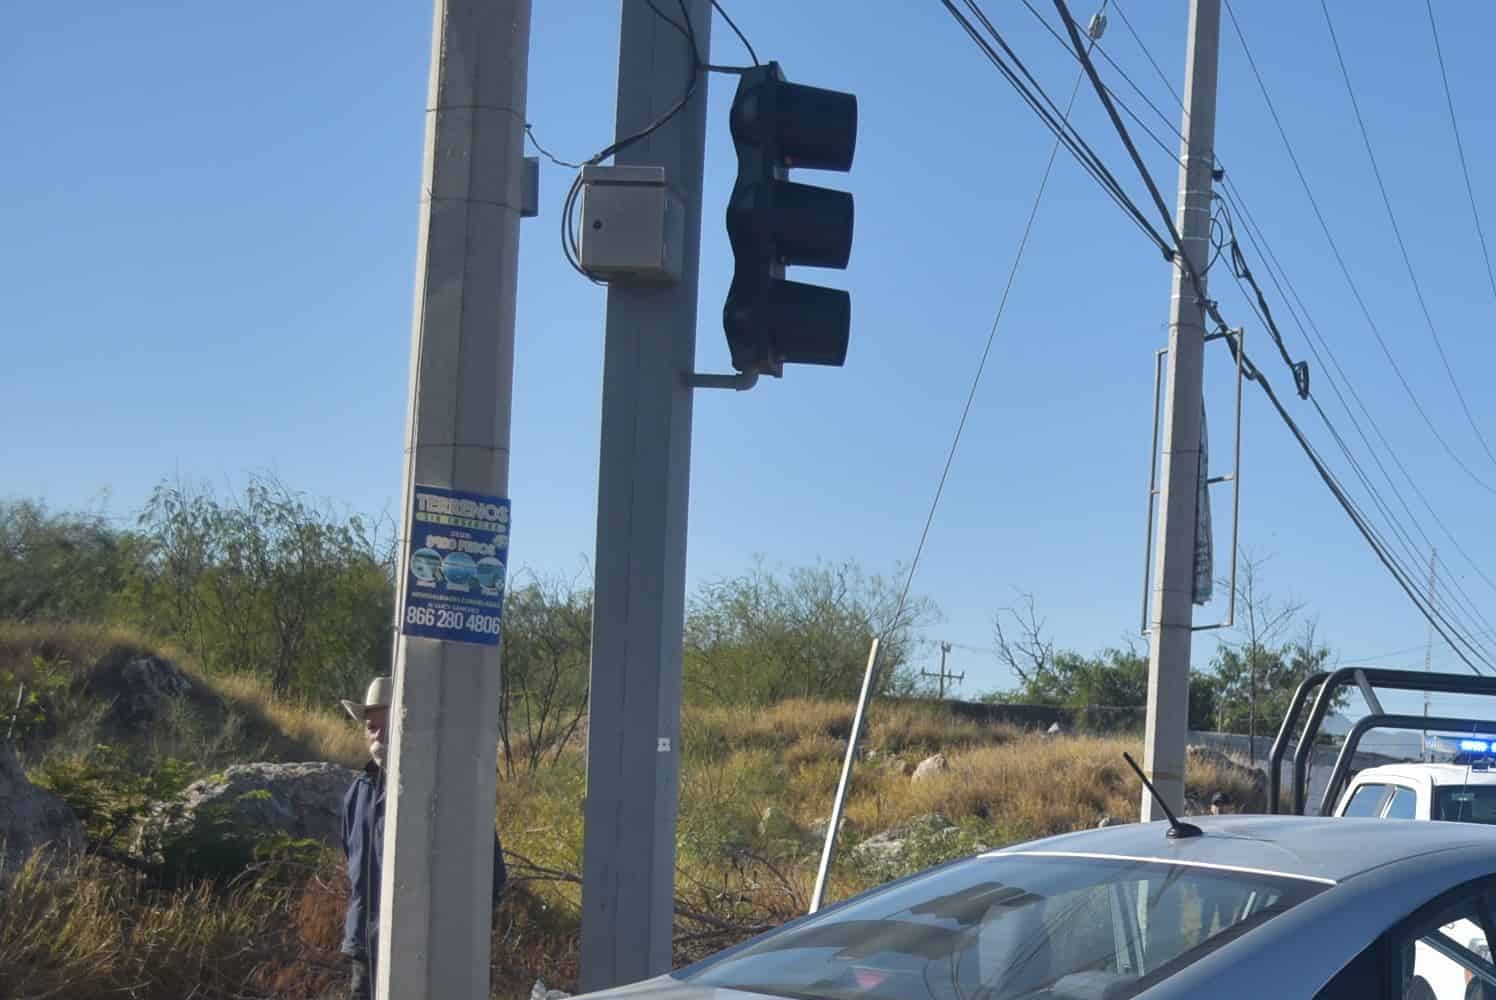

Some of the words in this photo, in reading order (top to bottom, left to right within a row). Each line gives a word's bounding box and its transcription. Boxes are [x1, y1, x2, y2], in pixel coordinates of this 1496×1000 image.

[407, 606, 435, 627] 866
[436, 609, 464, 630] 280
[465, 614, 501, 635] 4806
